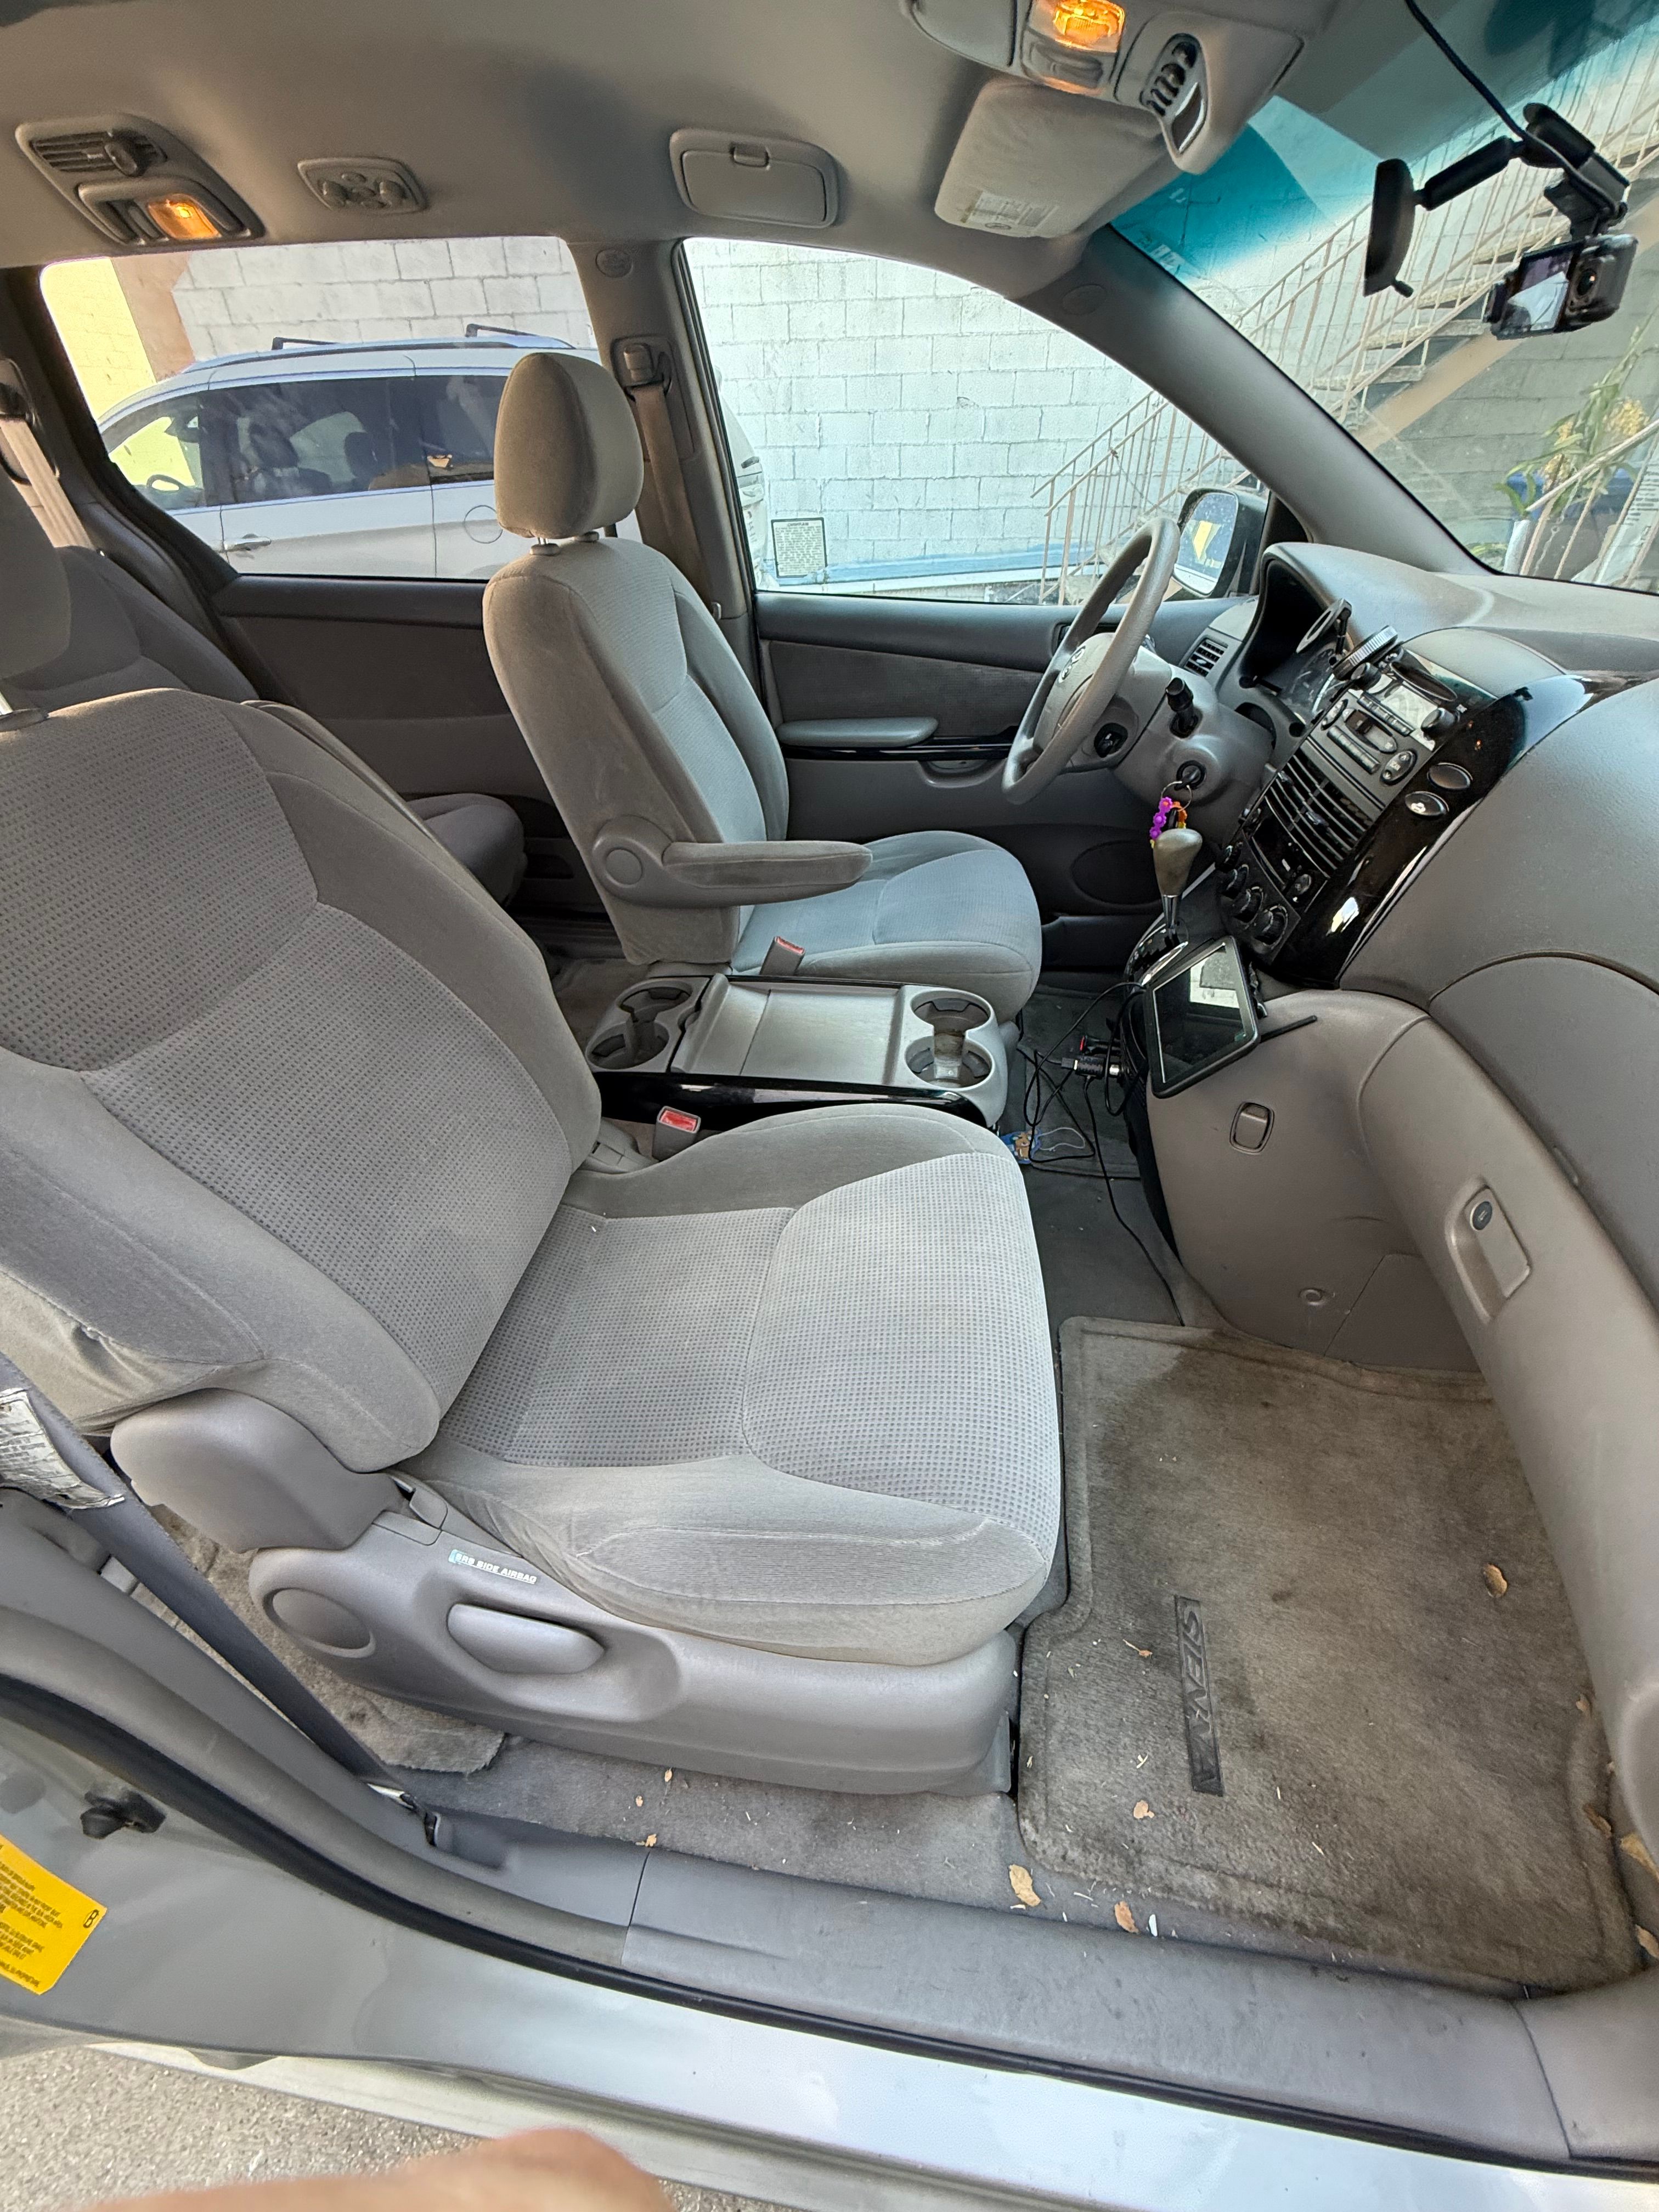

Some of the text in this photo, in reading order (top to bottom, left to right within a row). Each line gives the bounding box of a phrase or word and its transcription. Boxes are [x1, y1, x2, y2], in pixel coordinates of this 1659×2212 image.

[455, 1553, 537, 1583] SRS SIDE AIRBAG
